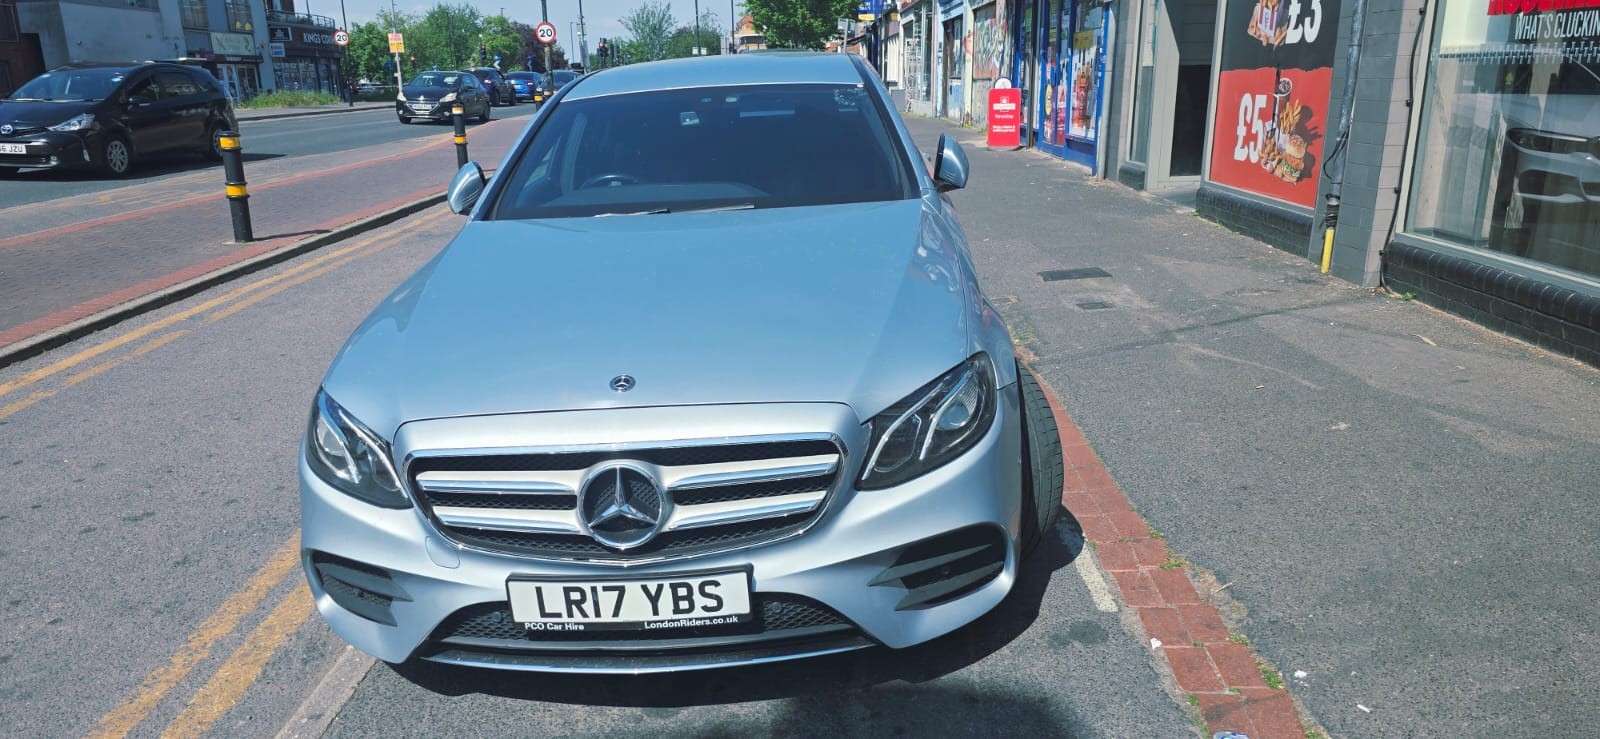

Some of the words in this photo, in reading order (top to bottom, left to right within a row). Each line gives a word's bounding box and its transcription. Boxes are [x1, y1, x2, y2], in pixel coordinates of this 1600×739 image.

[539, 28, 553, 37] 20
[1285, 0, 1322, 44] £3
[1514, 13, 1553, 40] WHAT'S
[303, 32, 321, 43] KINGS
[1233, 93, 1267, 162] £5
[535, 584, 627, 619] LR17
[640, 579, 724, 617] YBS
[524, 622, 544, 631] PCO
[547, 622, 563, 631] Car
[564, 622, 584, 631] Hire
[644, 615, 738, 630] LondonRiders.co.uk
